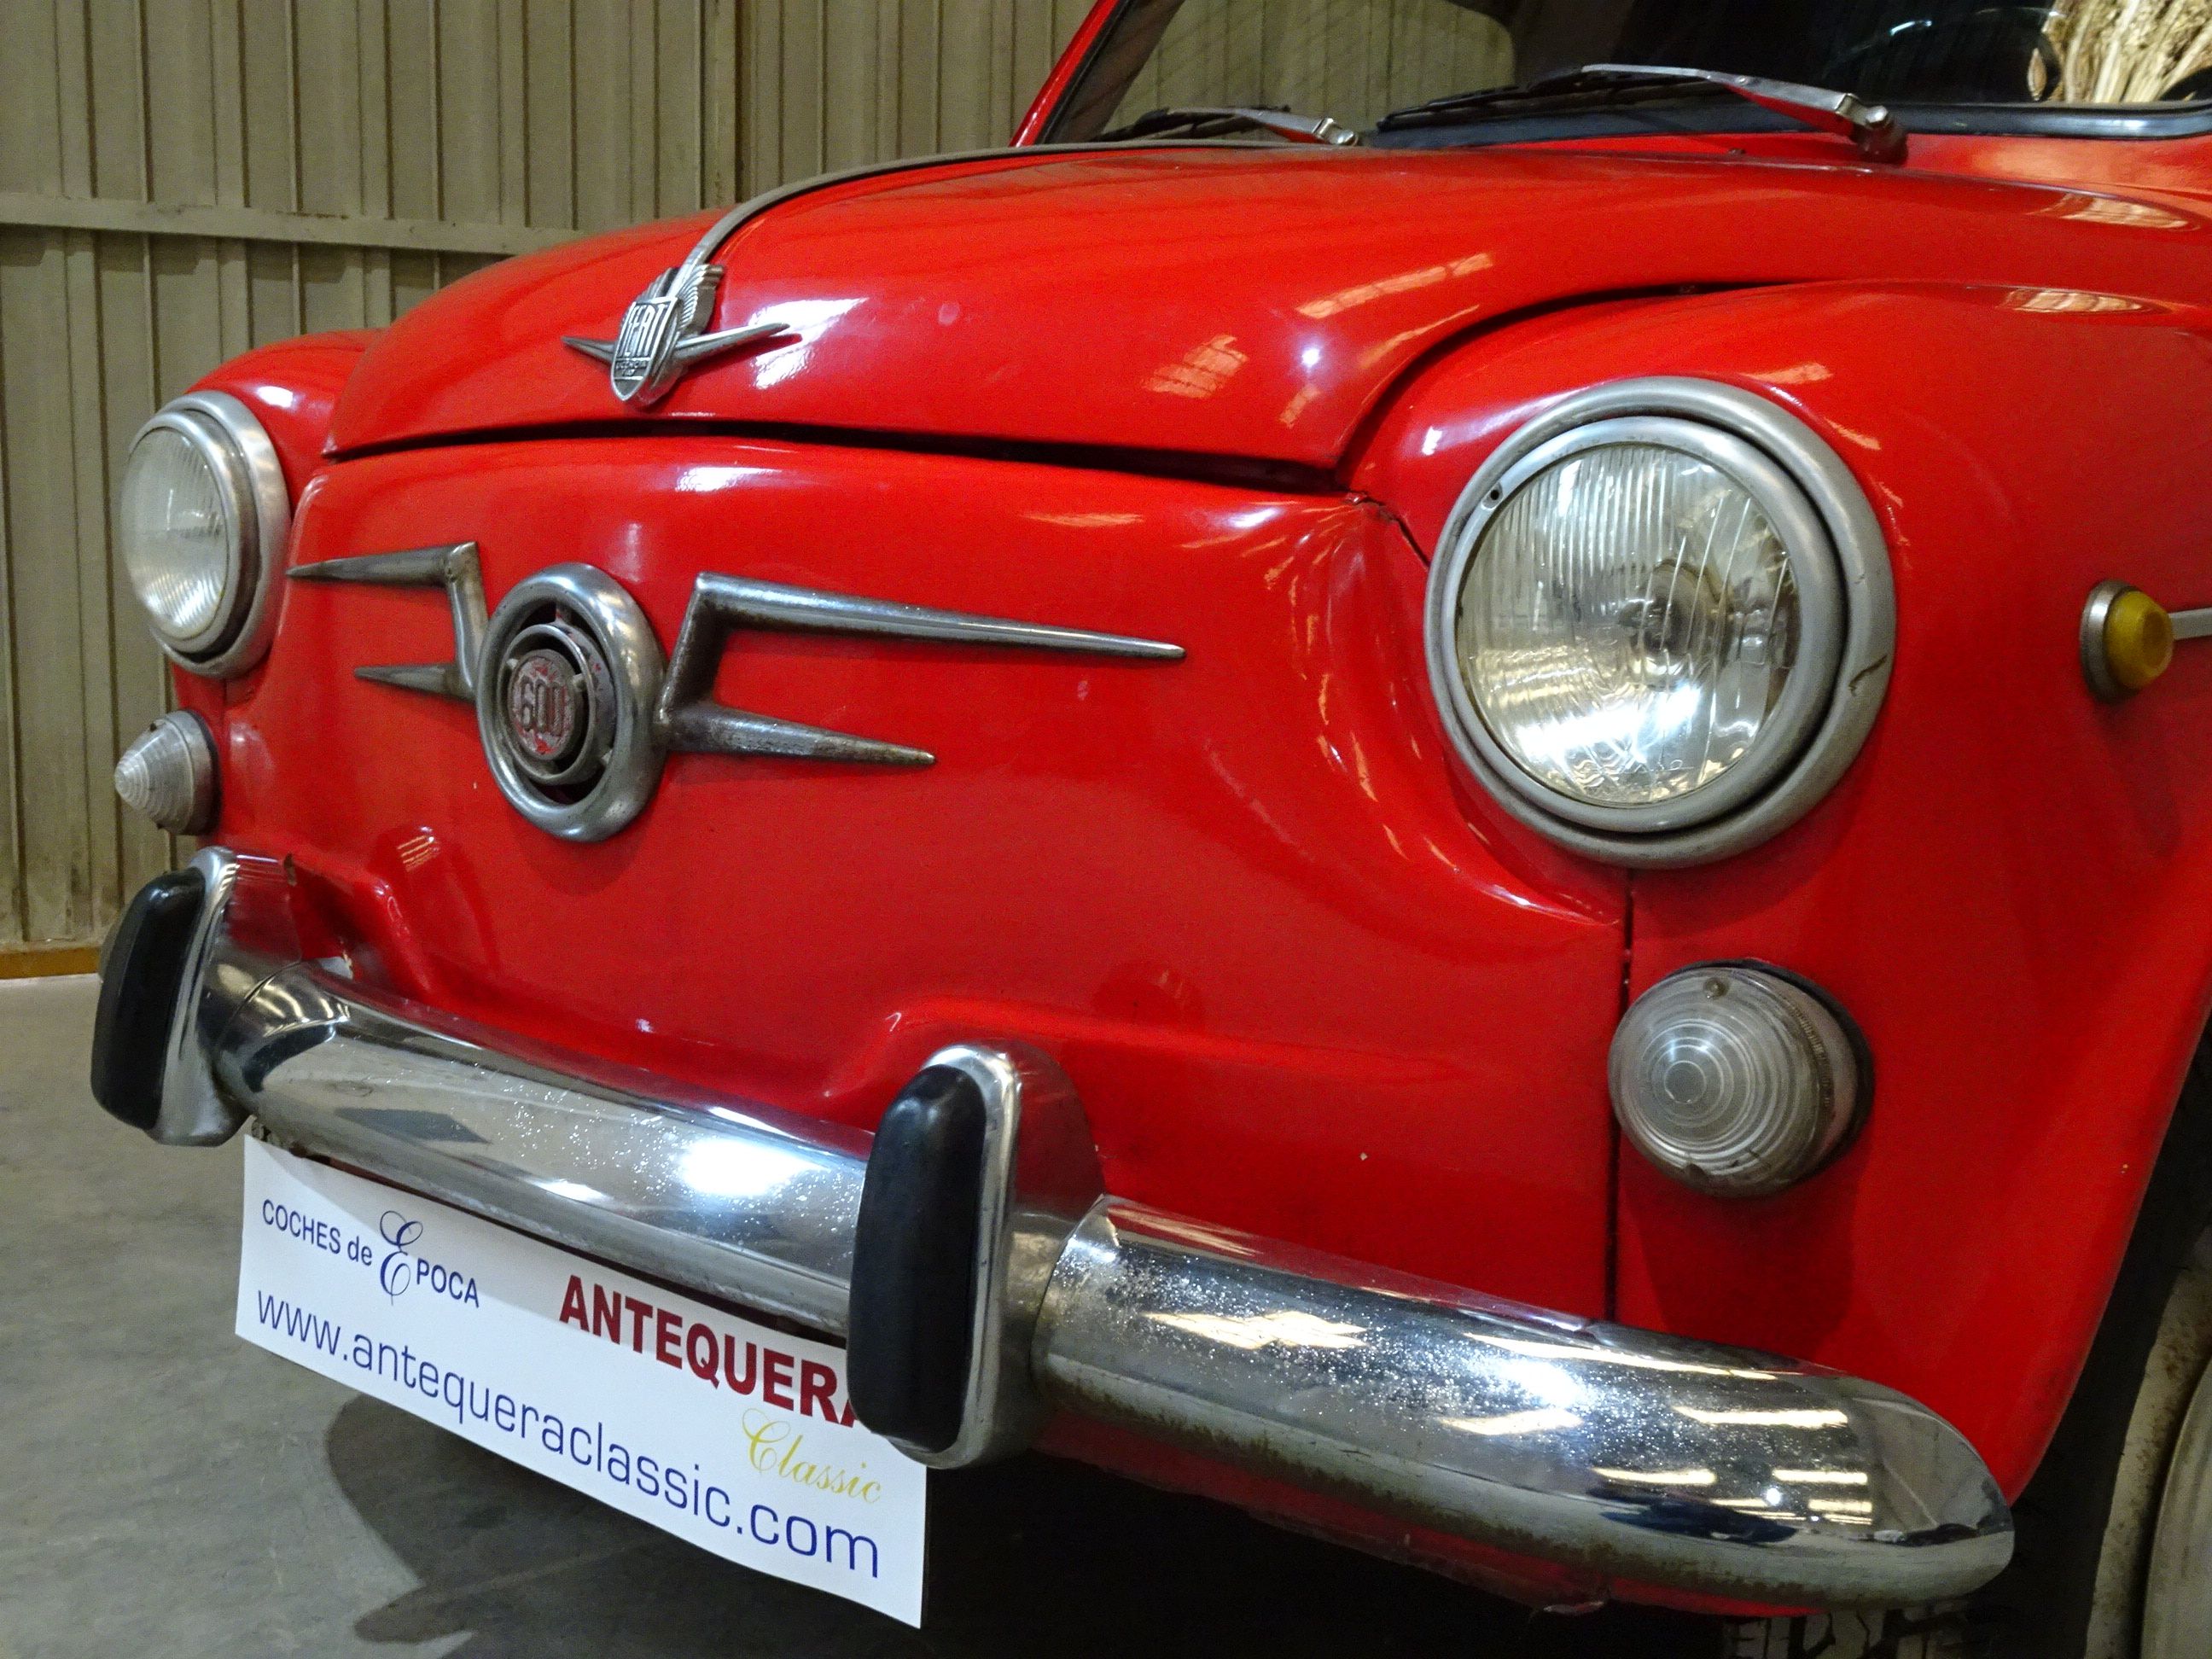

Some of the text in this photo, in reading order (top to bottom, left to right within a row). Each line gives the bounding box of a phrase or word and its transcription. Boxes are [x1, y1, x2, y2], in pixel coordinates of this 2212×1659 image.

[262, 1198, 341, 1254] COCHES
[346, 1235, 372, 1266] de
[258, 1289, 879, 1578] www.antequeraclassic.com
[742, 1407, 882, 1504] Classic
